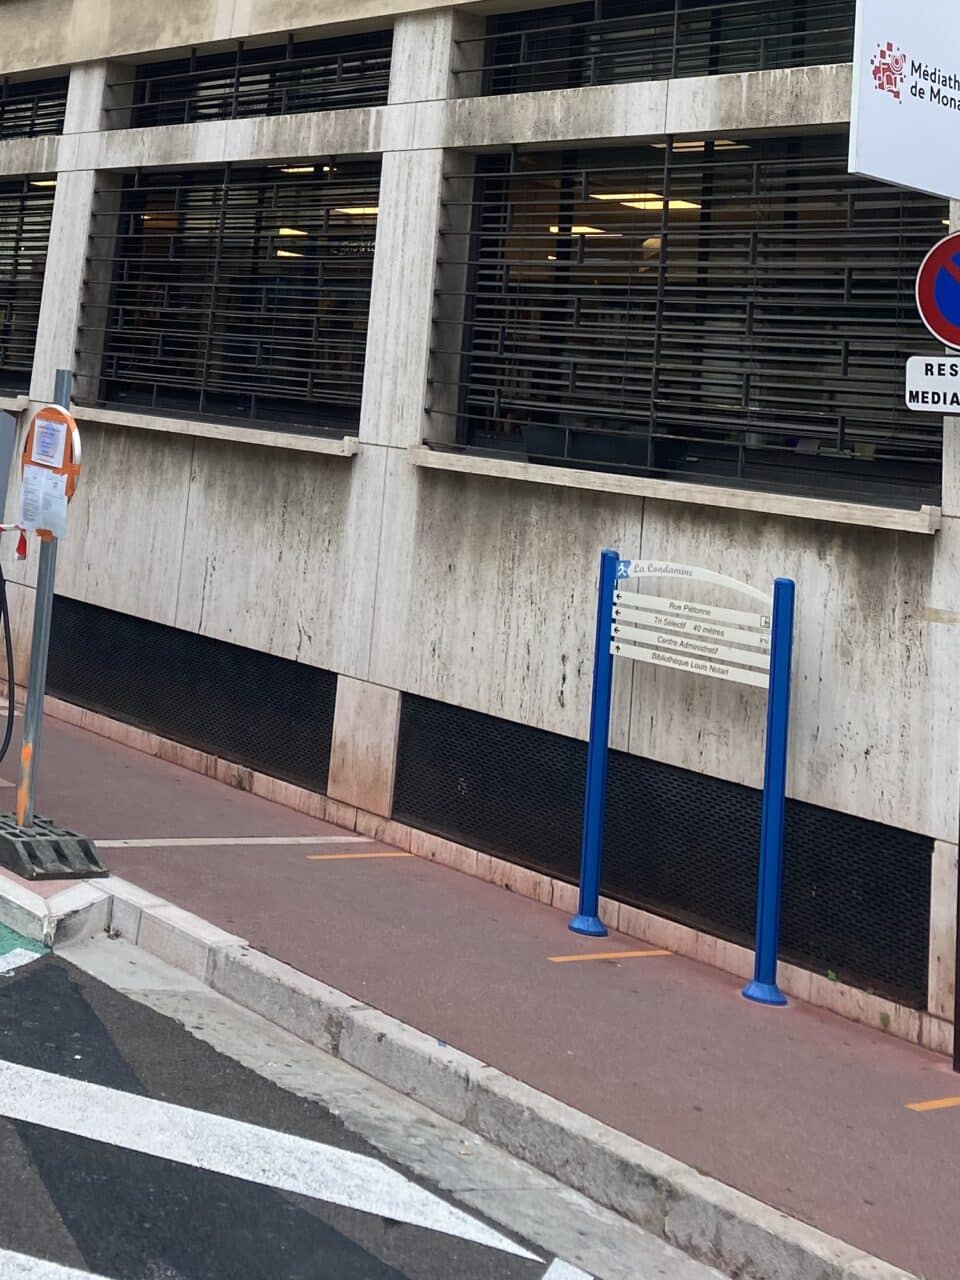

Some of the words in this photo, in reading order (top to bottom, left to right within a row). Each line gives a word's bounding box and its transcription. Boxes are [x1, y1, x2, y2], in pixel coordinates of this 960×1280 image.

[910, 59, 960, 92] Médiath
[910, 80, 925, 99] de
[924, 362, 959, 377] RES
[908, 390, 960, 406] MEDIA
[633, 564, 645, 573] La
[669, 602, 682, 611] Rue
